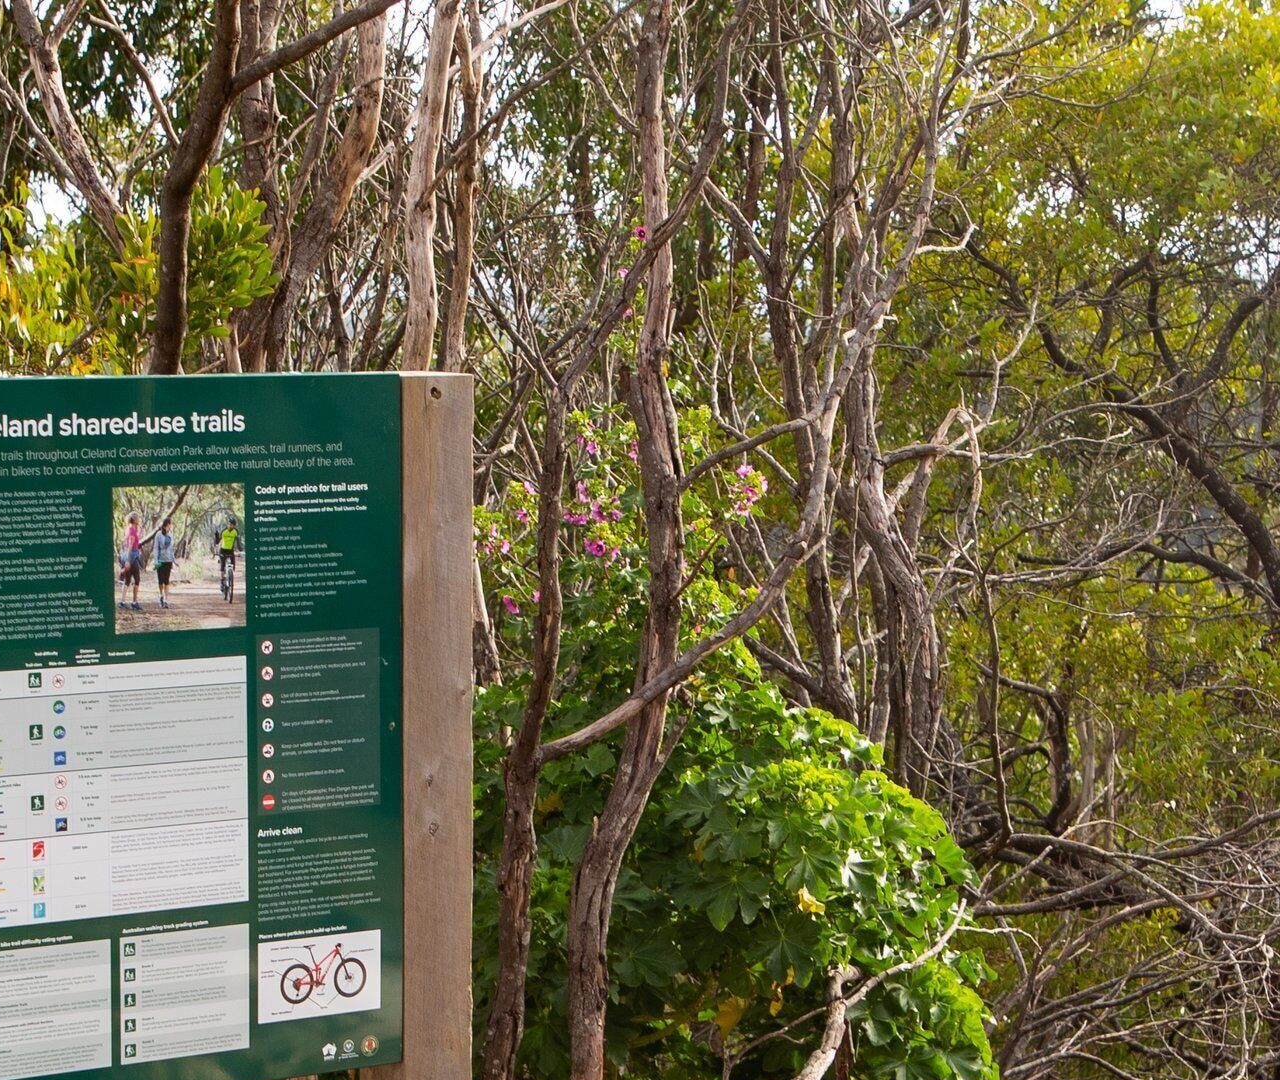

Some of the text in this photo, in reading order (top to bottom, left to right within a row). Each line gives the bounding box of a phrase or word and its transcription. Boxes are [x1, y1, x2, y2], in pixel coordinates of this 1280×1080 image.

[60, 410, 185, 437] shared-use
[192, 408, 245, 433] trails
[1, 449, 24, 461] trails
[26, 447, 78, 463] throughout
[81, 446, 117, 459] Cleland
[119, 444, 181, 458] Conservation
[183, 444, 203, 456] Park
[206, 443, 230, 455] allow
[231, 442, 268, 456] walkers,
[270, 441, 286, 454] trail
[288, 443, 324, 454] runners,
[326, 440, 343, 452] and
[11, 463, 41, 476] bikers
[43, 463, 53, 475] to
[56, 462, 94, 475] connect
[96, 461, 116, 474] with
[118, 460, 148, 473] nature
[151, 460, 168, 472] and
[170, 458, 222, 474] experience
[224, 457, 239, 470] the
[241, 456, 272, 469] natural
[273, 455, 304, 471] beauty
[306, 455, 315, 467] of
[317, 455, 332, 467] the
[334, 457, 356, 466] area.
[255, 485, 276, 494] Code
[278, 485, 286, 494] of
[287, 483, 318, 495] practice
[319, 483, 330, 492] for
[331, 482, 347, 492] trail
[257, 826, 303, 838] Arrive clean
